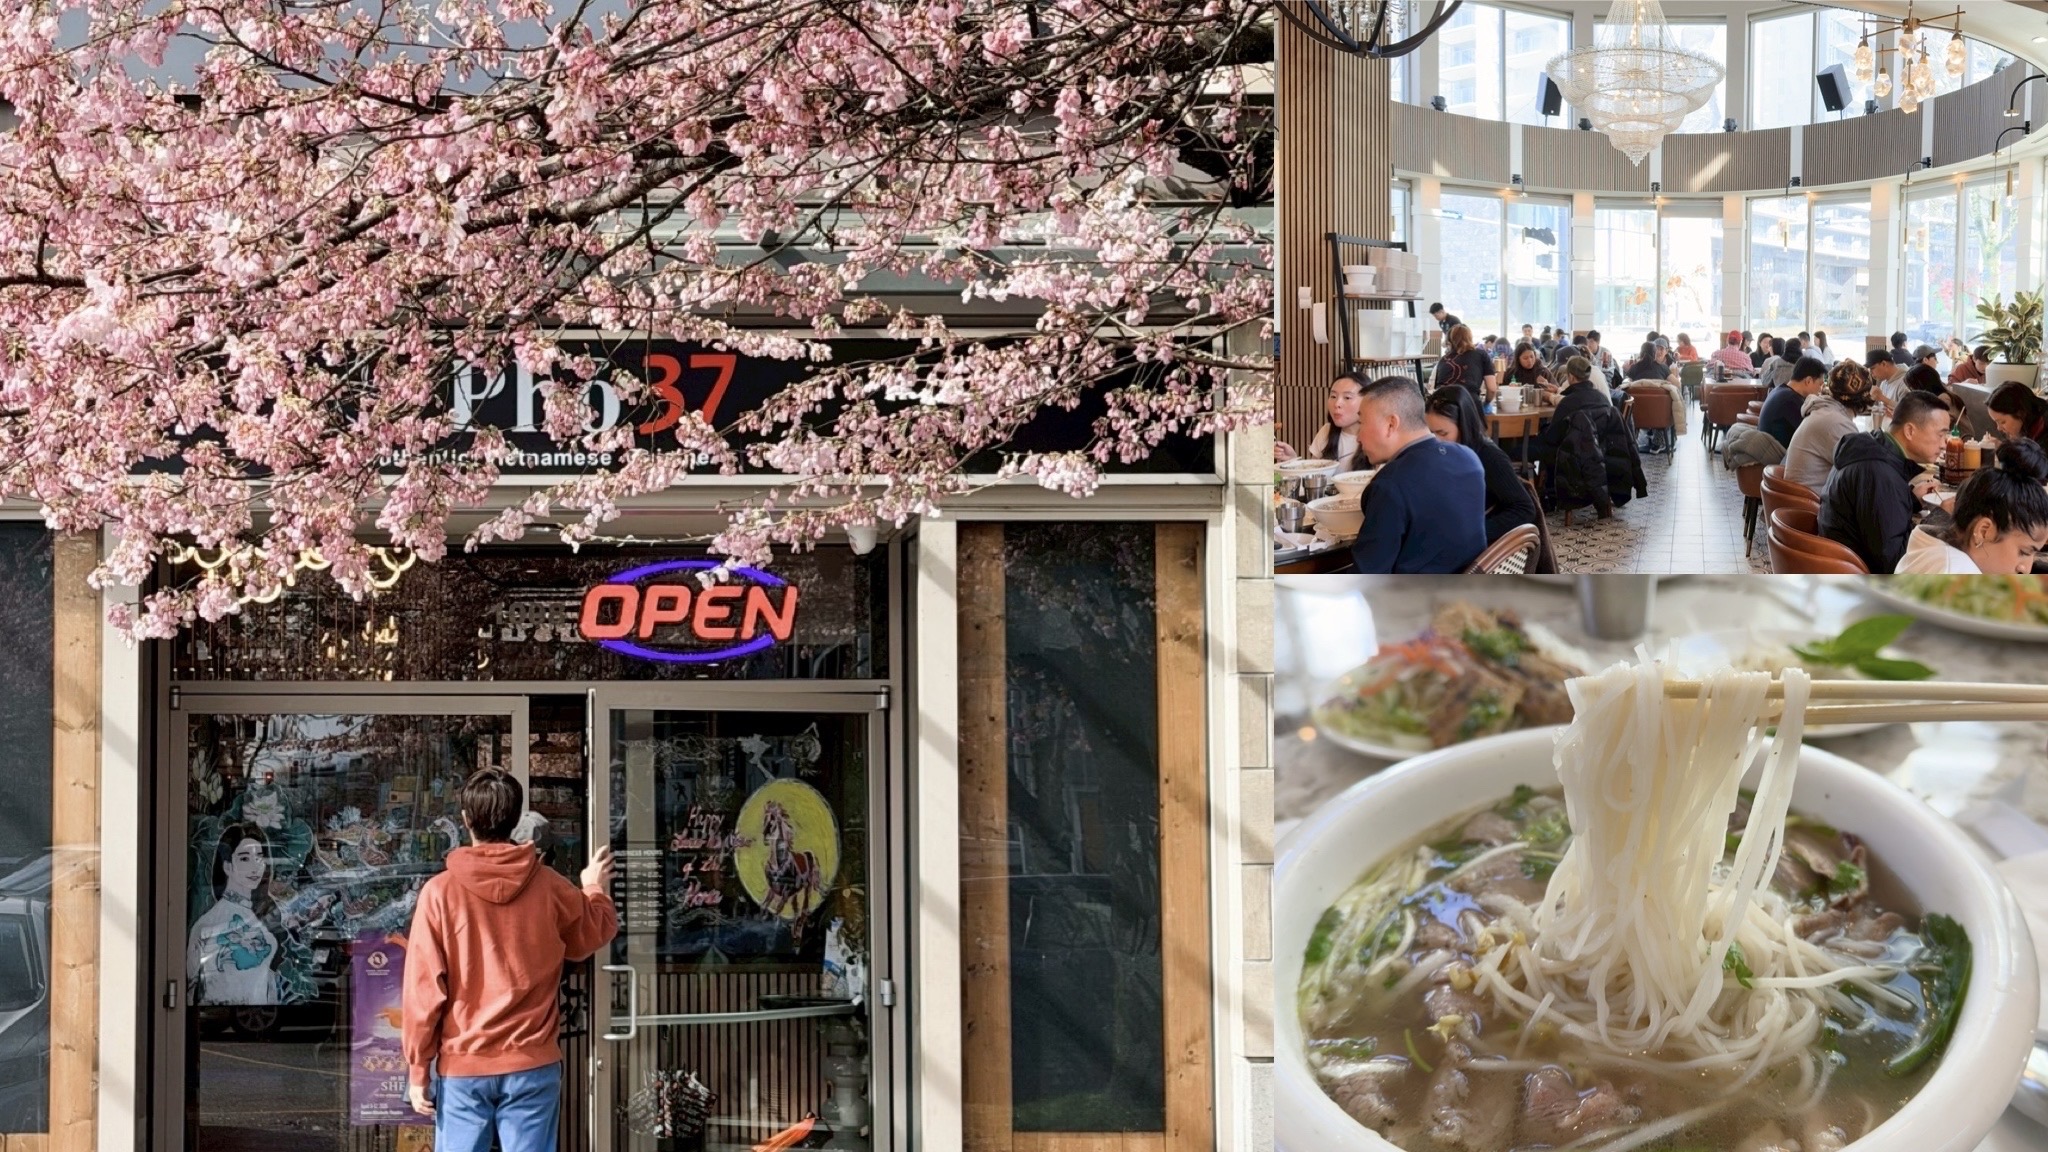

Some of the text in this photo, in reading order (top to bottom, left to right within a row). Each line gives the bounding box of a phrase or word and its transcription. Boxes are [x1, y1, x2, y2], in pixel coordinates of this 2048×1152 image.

[639, 354, 737, 435] 37
[494, 448, 612, 467] ietnamese
[579, 584, 798, 640] OPEN
